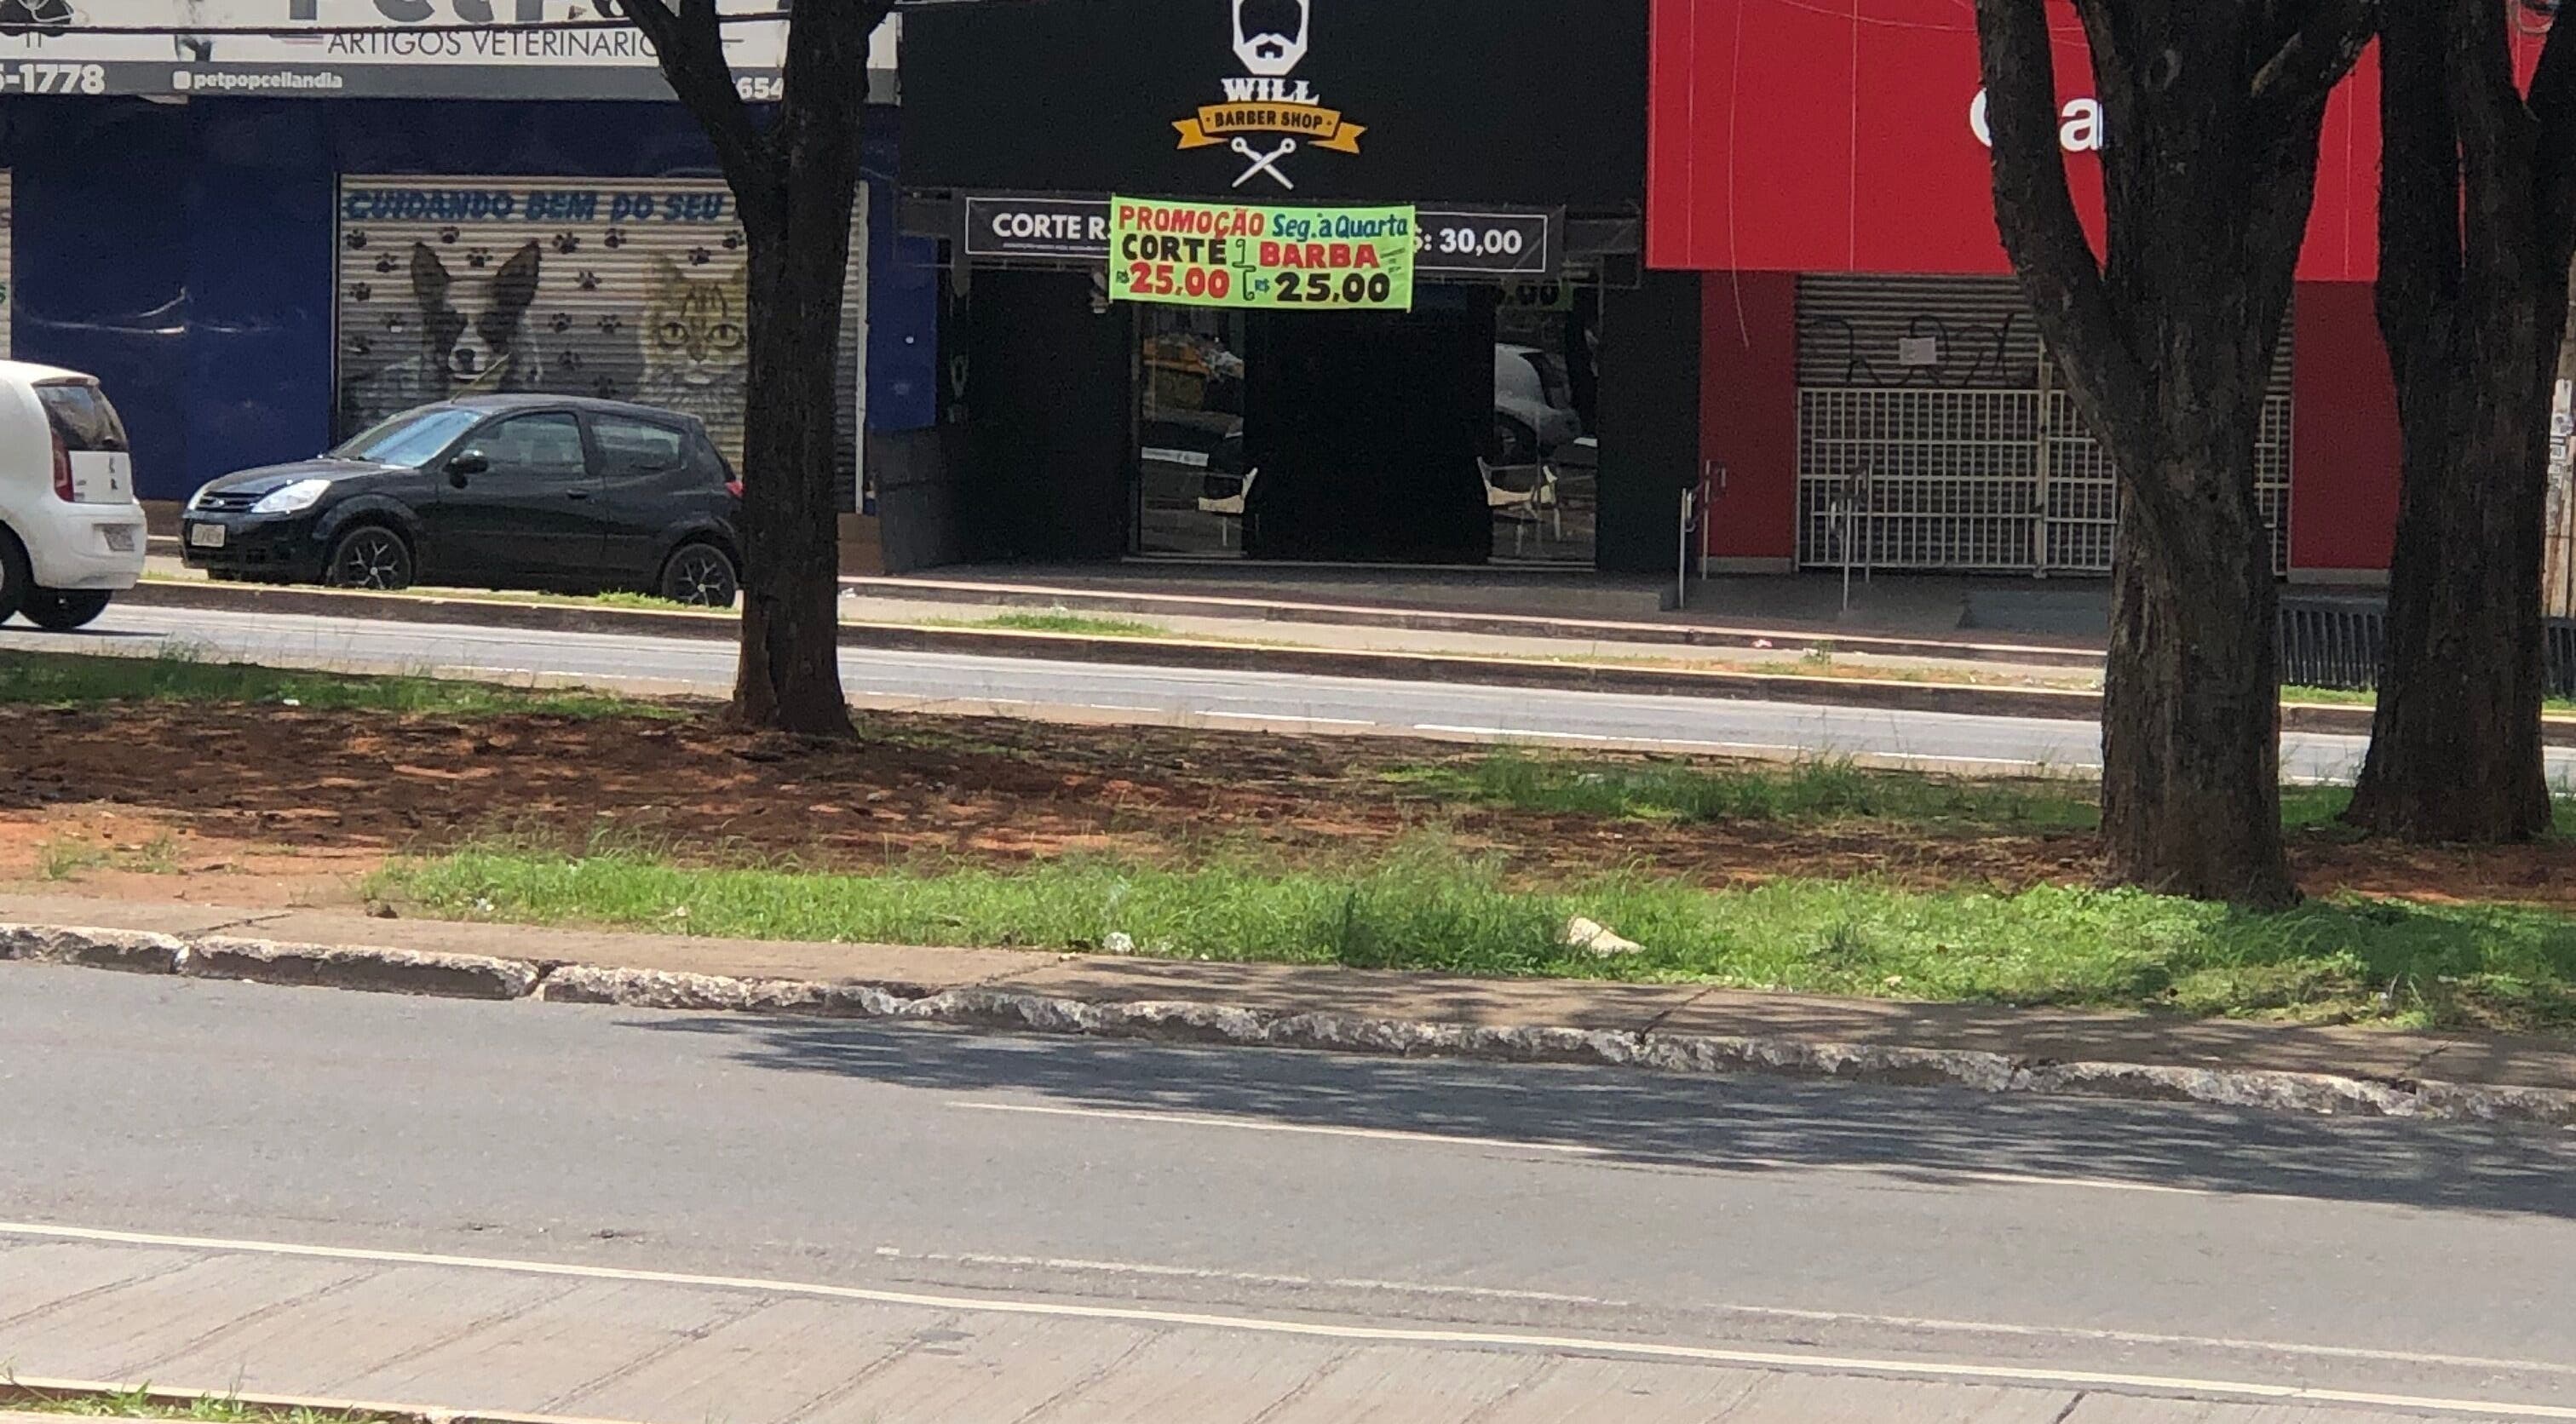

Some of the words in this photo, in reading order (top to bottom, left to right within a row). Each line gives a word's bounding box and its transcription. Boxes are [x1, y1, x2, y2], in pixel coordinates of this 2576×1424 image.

[328, 31, 461, 55] ARTIGOS
[0, 64, 105, 94] -1778
[1221, 78, 1320, 106] WILL
[1214, 110, 1276, 128] BARBER
[1280, 111, 1323, 130] SHOP
[345, 188, 514, 220] CUIDANDO
[526, 189, 597, 221] BEM
[664, 192, 725, 221] SEU
[992, 213, 1081, 239] CORTE
[1088, 215, 1111, 241] R
[1118, 205, 1265, 238] PROMOÇÃO
[1272, 213, 1317, 242] Seg.
[1335, 214, 1408, 238] Quarta
[1121, 233, 1228, 266] CORTE
[1259, 242, 1381, 269] BARBA
[1439, 227, 1522, 256] 30,00
[1130, 262, 1231, 299] 25,00
[1274, 272, 1391, 302] 25,00
